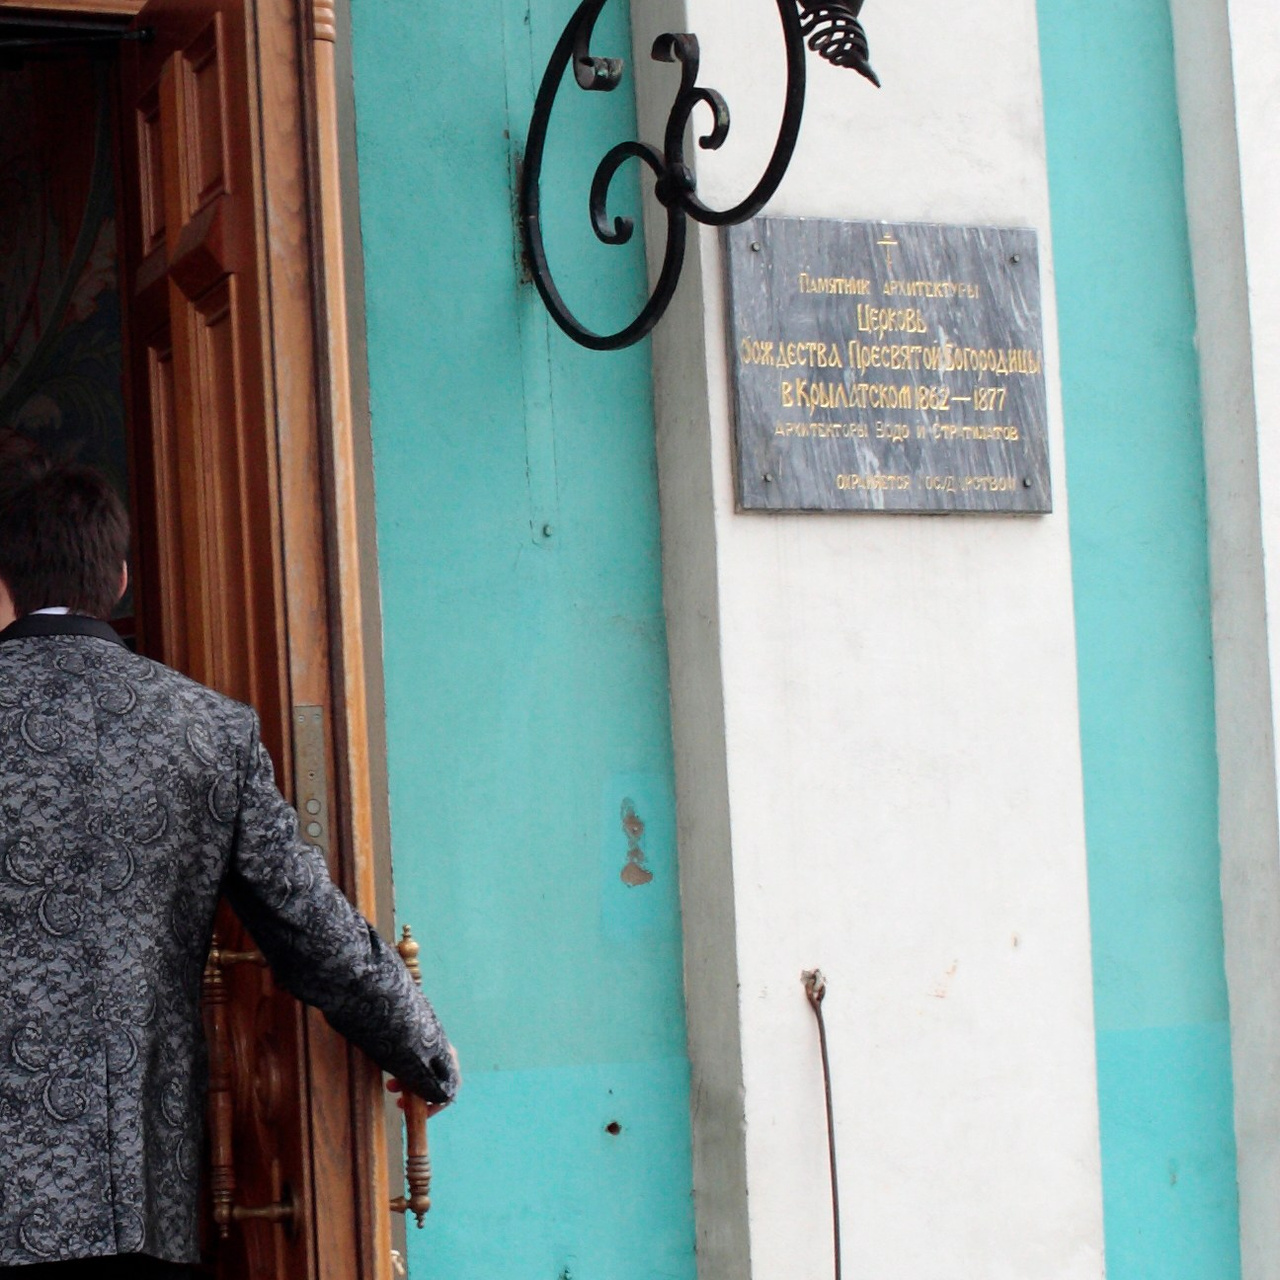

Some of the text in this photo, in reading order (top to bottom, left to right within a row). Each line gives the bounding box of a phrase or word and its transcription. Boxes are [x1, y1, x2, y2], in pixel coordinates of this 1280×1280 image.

[857, 303, 927, 340] Церковь
[848, 339, 939, 376] Пресвятой
[944, 342, 1041, 380] Богородицы
[795, 377, 911, 415] Крылатском
